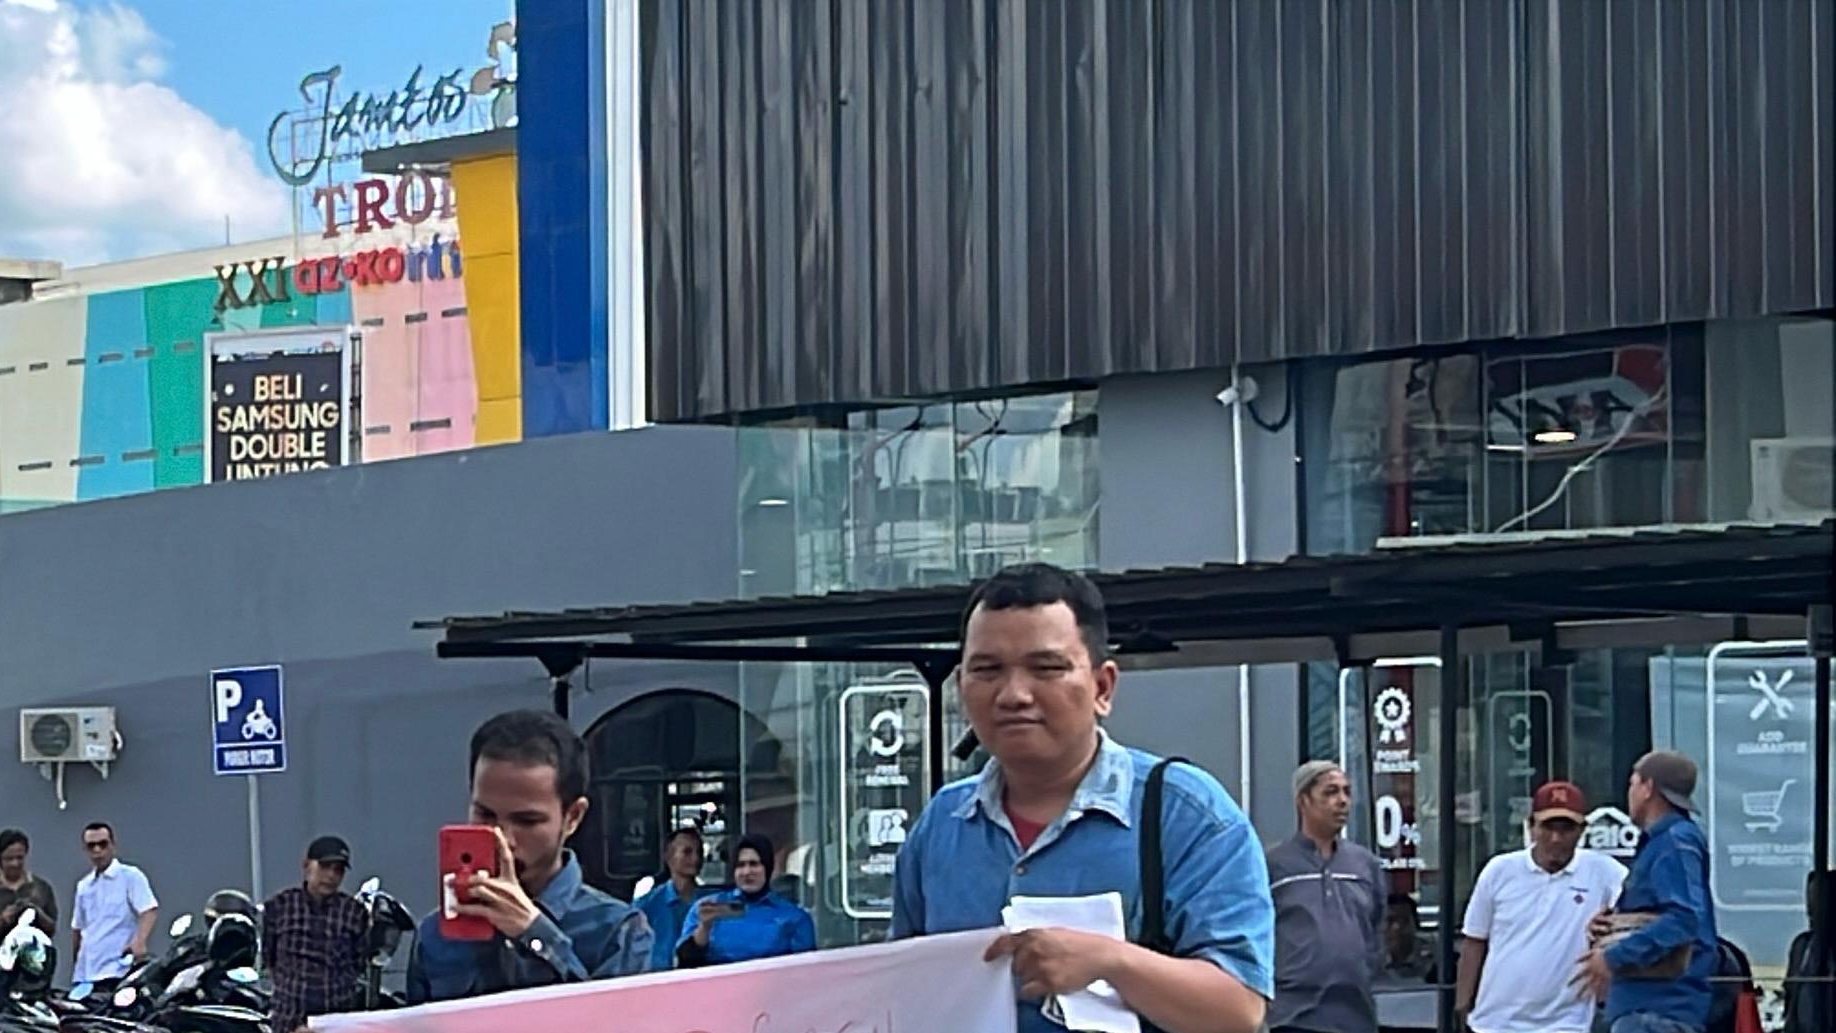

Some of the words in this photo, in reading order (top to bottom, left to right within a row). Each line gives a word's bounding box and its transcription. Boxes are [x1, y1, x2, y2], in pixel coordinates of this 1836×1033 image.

[213, 255, 292, 313] XXI
[254, 372, 302, 401] BELI
[216, 401, 340, 432] SAMSUNG
[230, 431, 326, 460] DOUBLE
[215, 680, 243, 723] P
